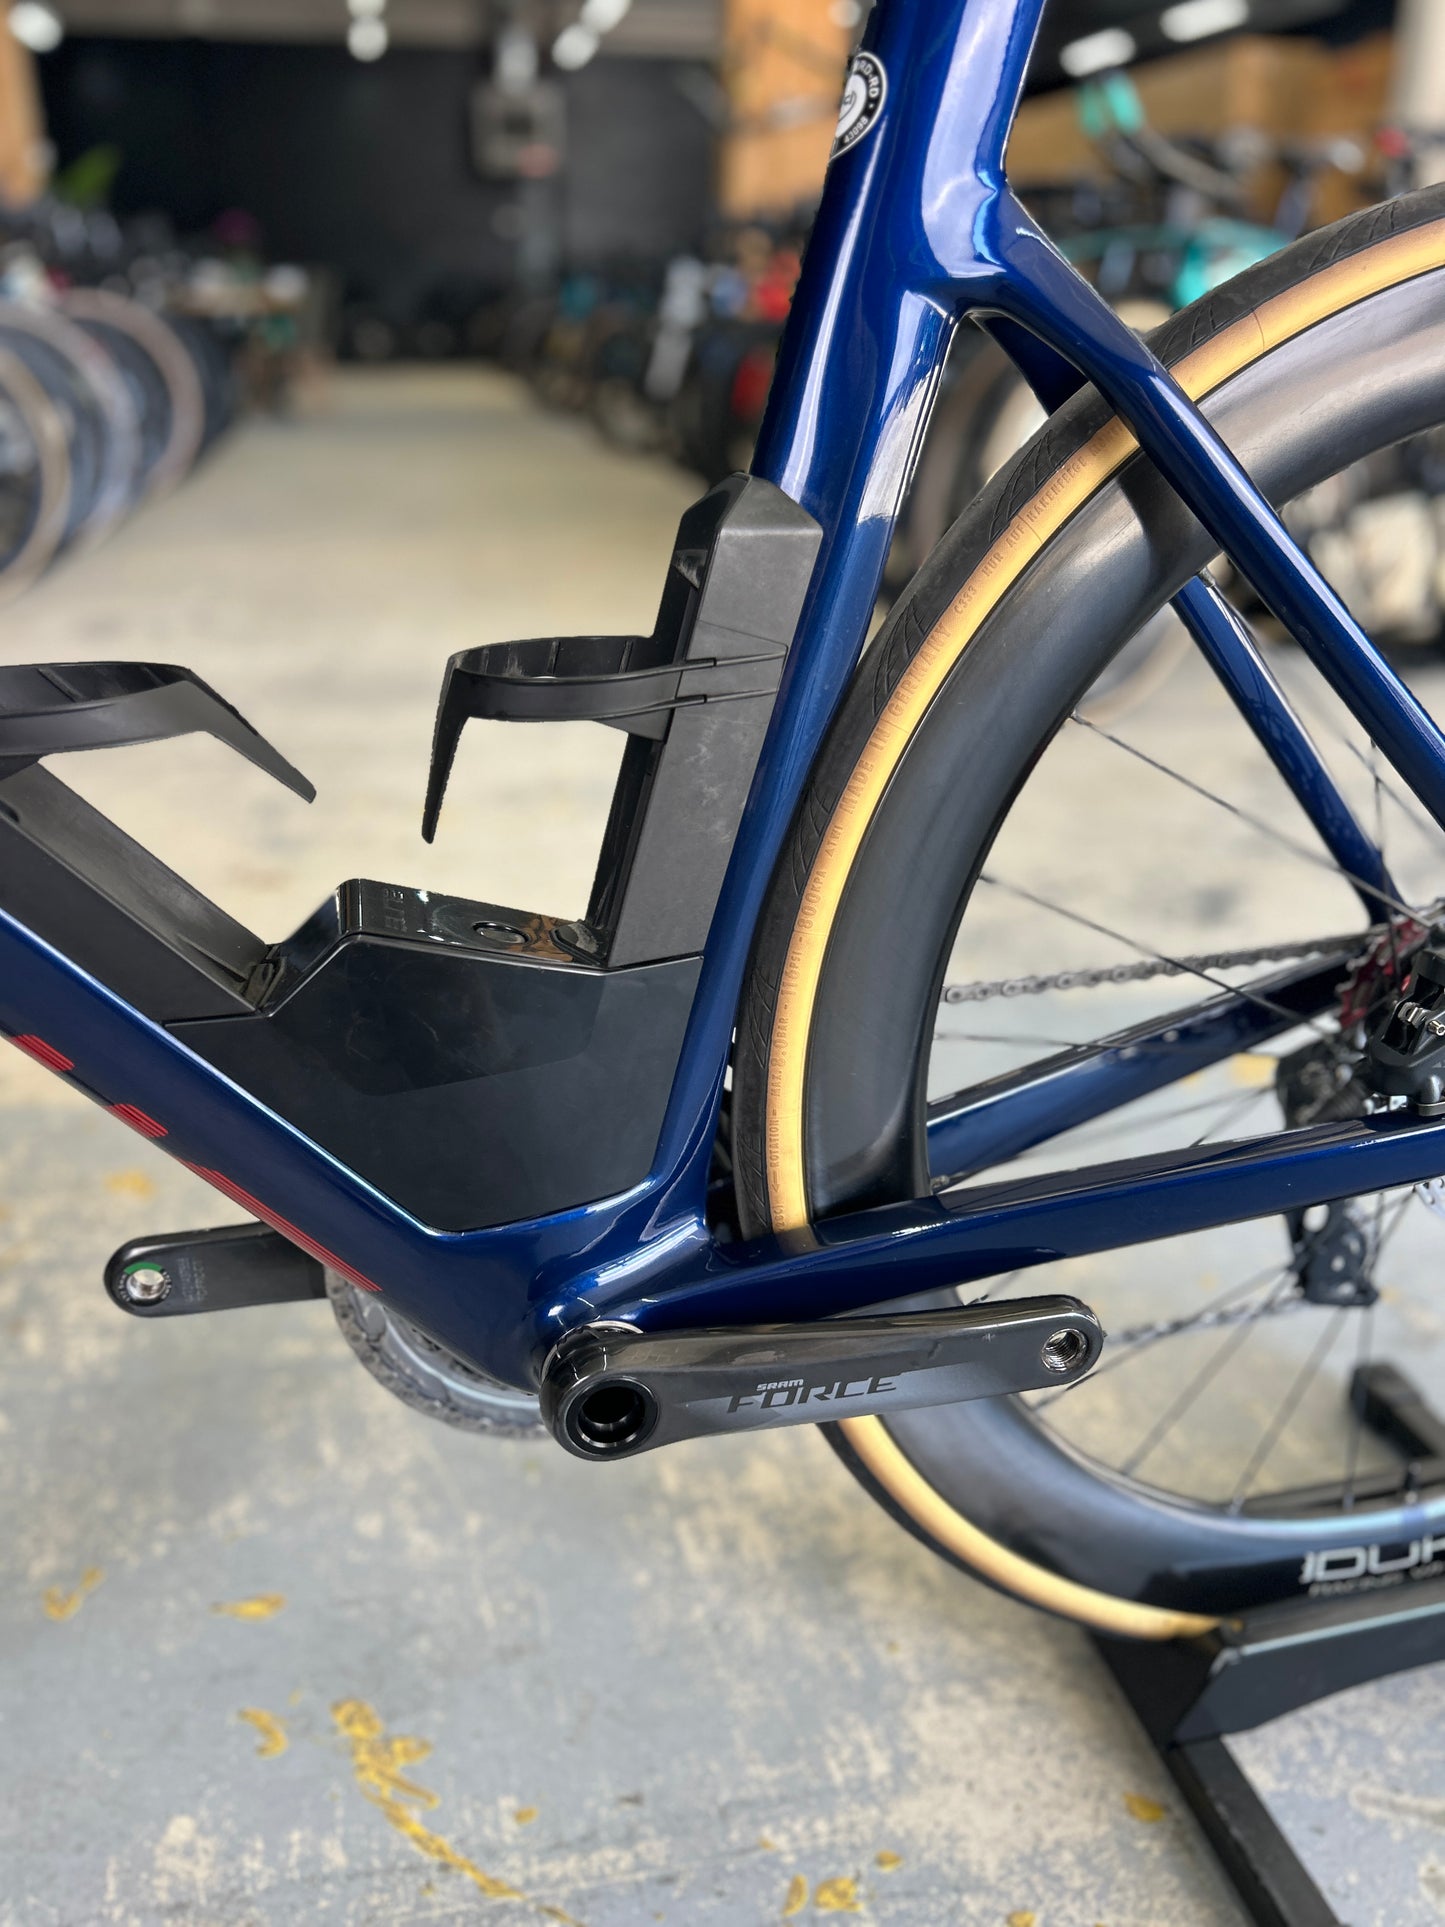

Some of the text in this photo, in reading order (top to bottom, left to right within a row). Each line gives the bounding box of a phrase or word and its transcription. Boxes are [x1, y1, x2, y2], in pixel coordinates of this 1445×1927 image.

[768, 1119, 780, 1168] ROTATION
[838, 758, 874, 815] MADE
[870, 725, 891, 751] IN
[887, 623, 951, 717] GERMANY
[727, 1374, 899, 1413] FORCE
[756, 1378, 805, 1392] SRAM
